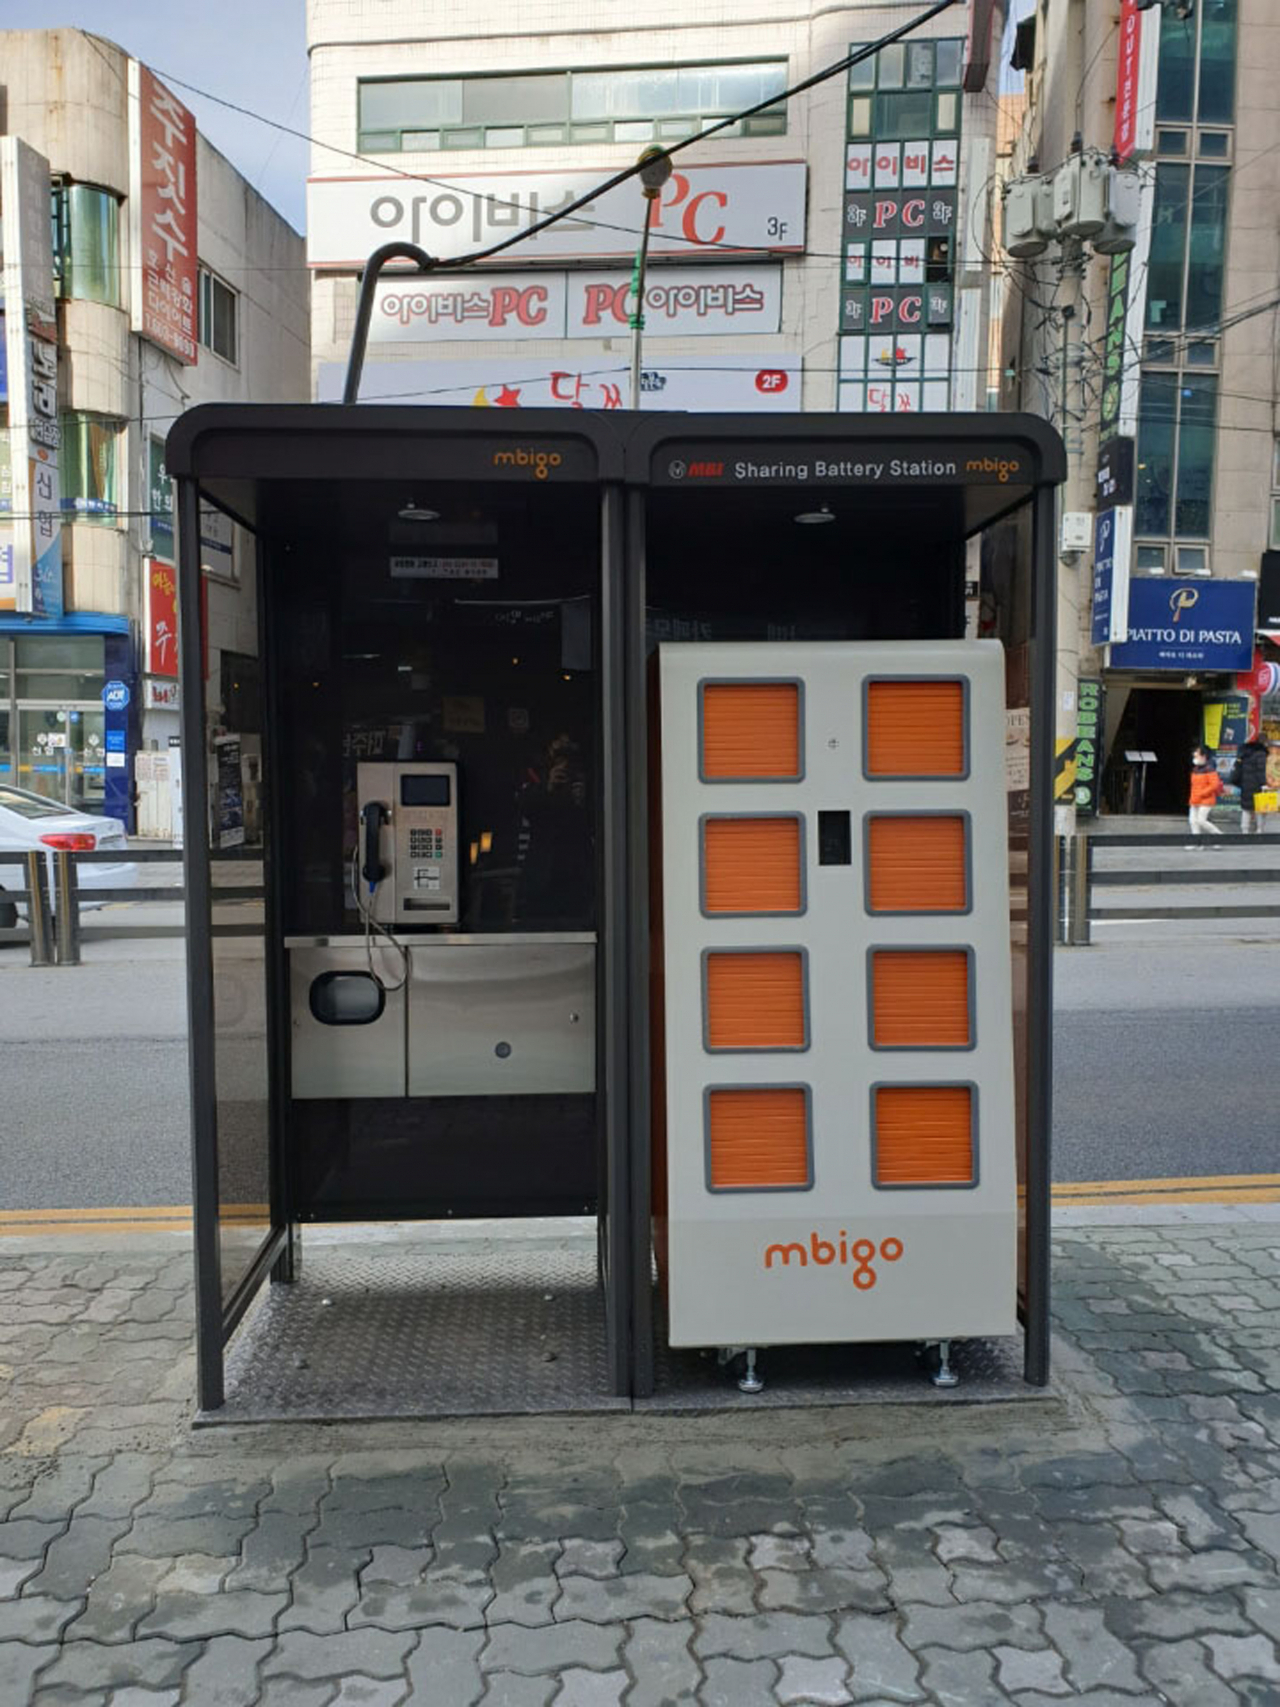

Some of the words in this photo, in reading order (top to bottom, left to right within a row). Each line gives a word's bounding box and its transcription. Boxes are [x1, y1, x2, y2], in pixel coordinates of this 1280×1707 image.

[150, 82, 188, 261] 주짓수
[846, 154, 955, 177] 아이비스
[371, 189, 596, 245] 아이비스
[644, 172, 728, 245] PC
[767, 216, 789, 241] 3F
[847, 204, 867, 228] 3F
[873, 200, 925, 228] PC
[933, 202, 953, 225] 3F
[869, 297, 922, 324] PC
[761, 374, 782, 389] 2F
[493, 449, 562, 479] mbigo
[735, 461, 809, 479] Sharing
[815, 460, 884, 479] Battery
[889, 460, 956, 476] Station
[966, 458, 1020, 482] mbigo
[37, 472, 53, 537] 신협
[1127, 627, 1176, 643] PIATTO
[1180, 629, 1195, 643] DI
[1199, 629, 1242, 644] PASTA
[765, 1230, 904, 1290] mbigo
